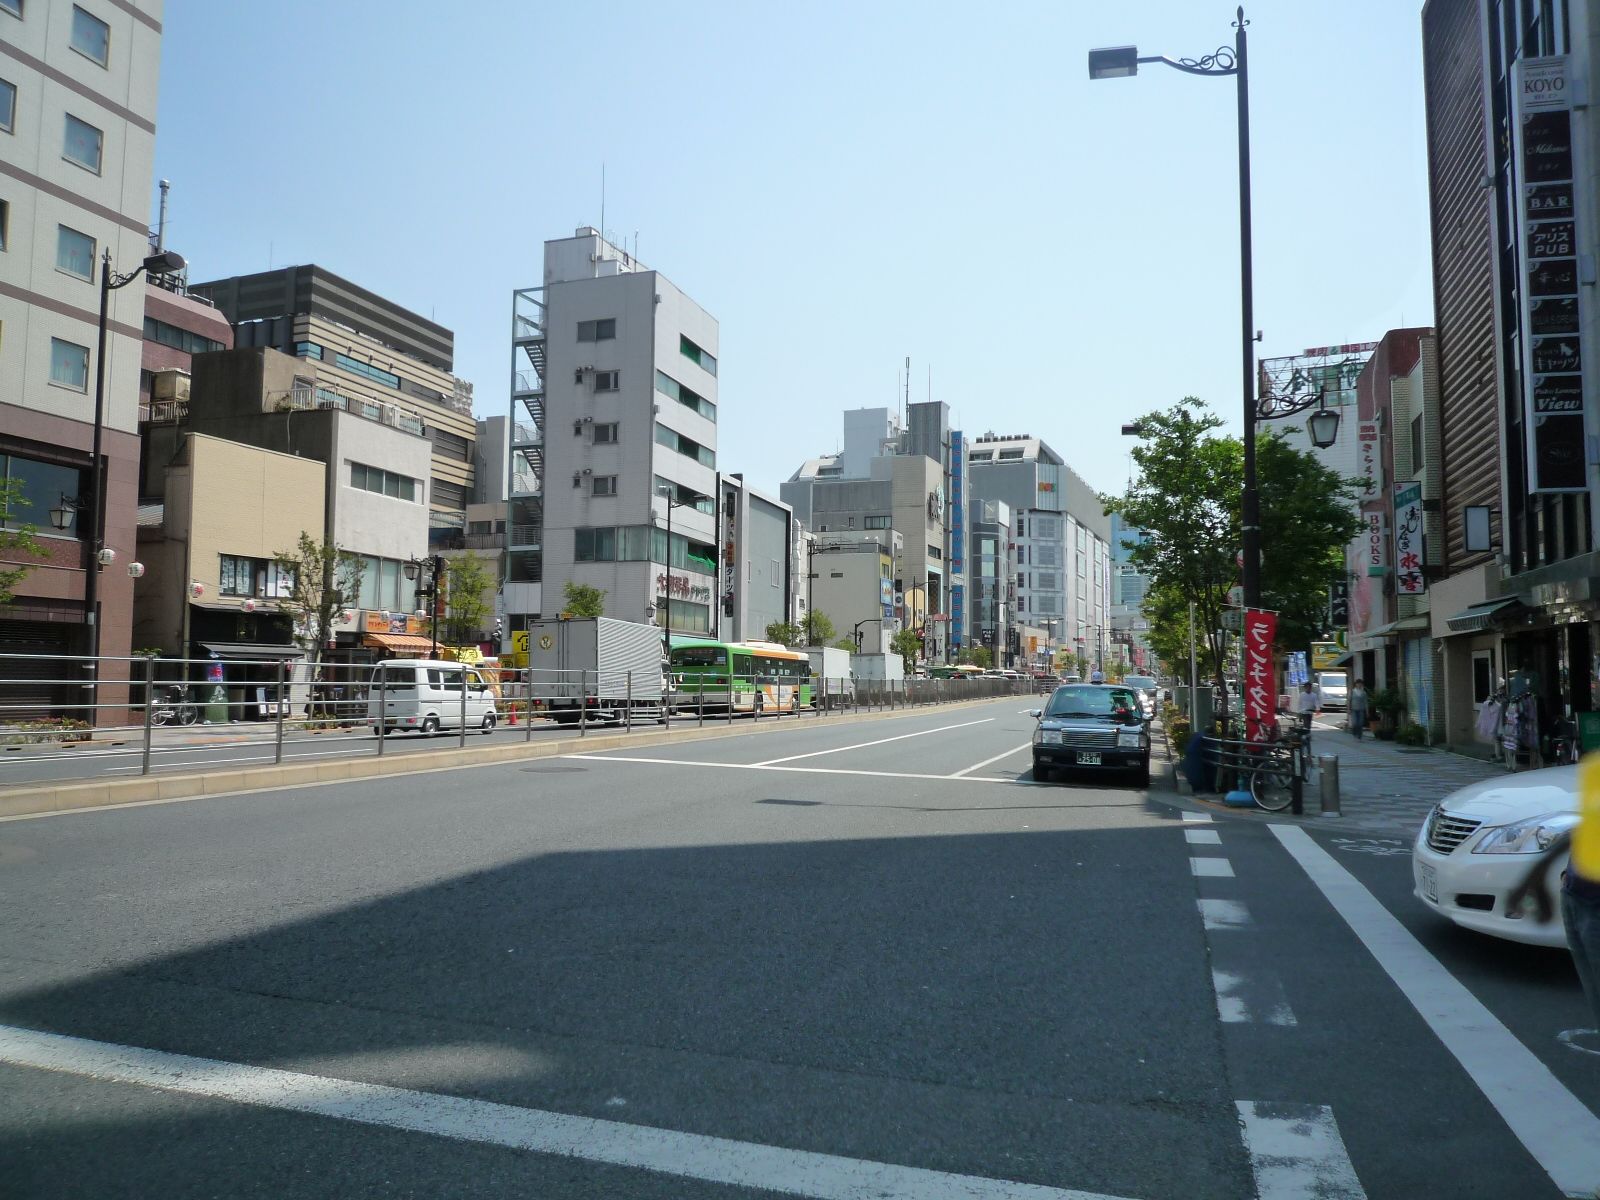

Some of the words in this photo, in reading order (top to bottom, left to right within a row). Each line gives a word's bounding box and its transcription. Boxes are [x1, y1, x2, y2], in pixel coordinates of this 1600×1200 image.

[1524, 77, 1564, 94] KOYO
[1531, 196, 1569, 209] BAR
[1534, 232, 1569, 244] アリス
[1534, 244, 1569, 256] PUB
[1535, 356, 1579, 370] キャッツ
[1537, 397, 1580, 411] View
